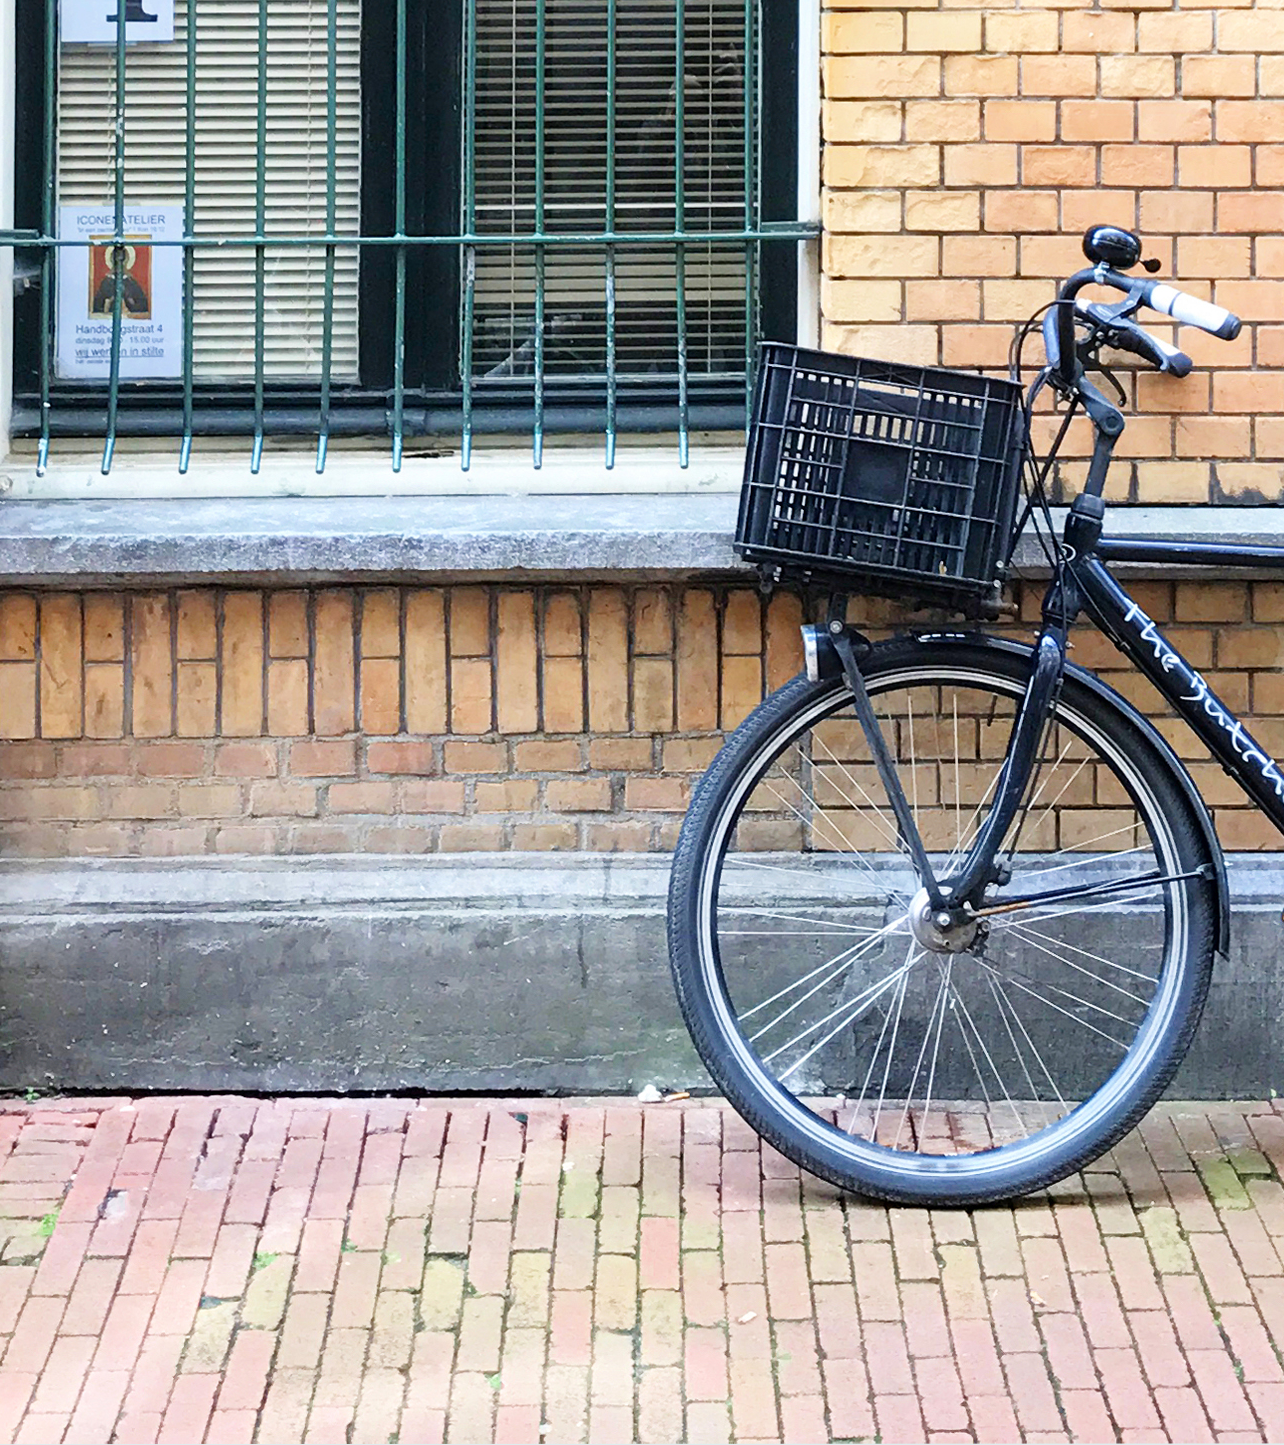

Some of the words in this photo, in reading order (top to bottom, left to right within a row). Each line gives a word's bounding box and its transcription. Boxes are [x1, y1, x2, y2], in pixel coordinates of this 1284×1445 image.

[76, 214, 166, 226] ICONEATELIER
[75, 324, 155, 336] Handbogstraat
[156, 324, 164, 333] 4
[90, 348, 127, 356] wern
[129, 347, 139, 356] in
[141, 346, 164, 356] stilte
